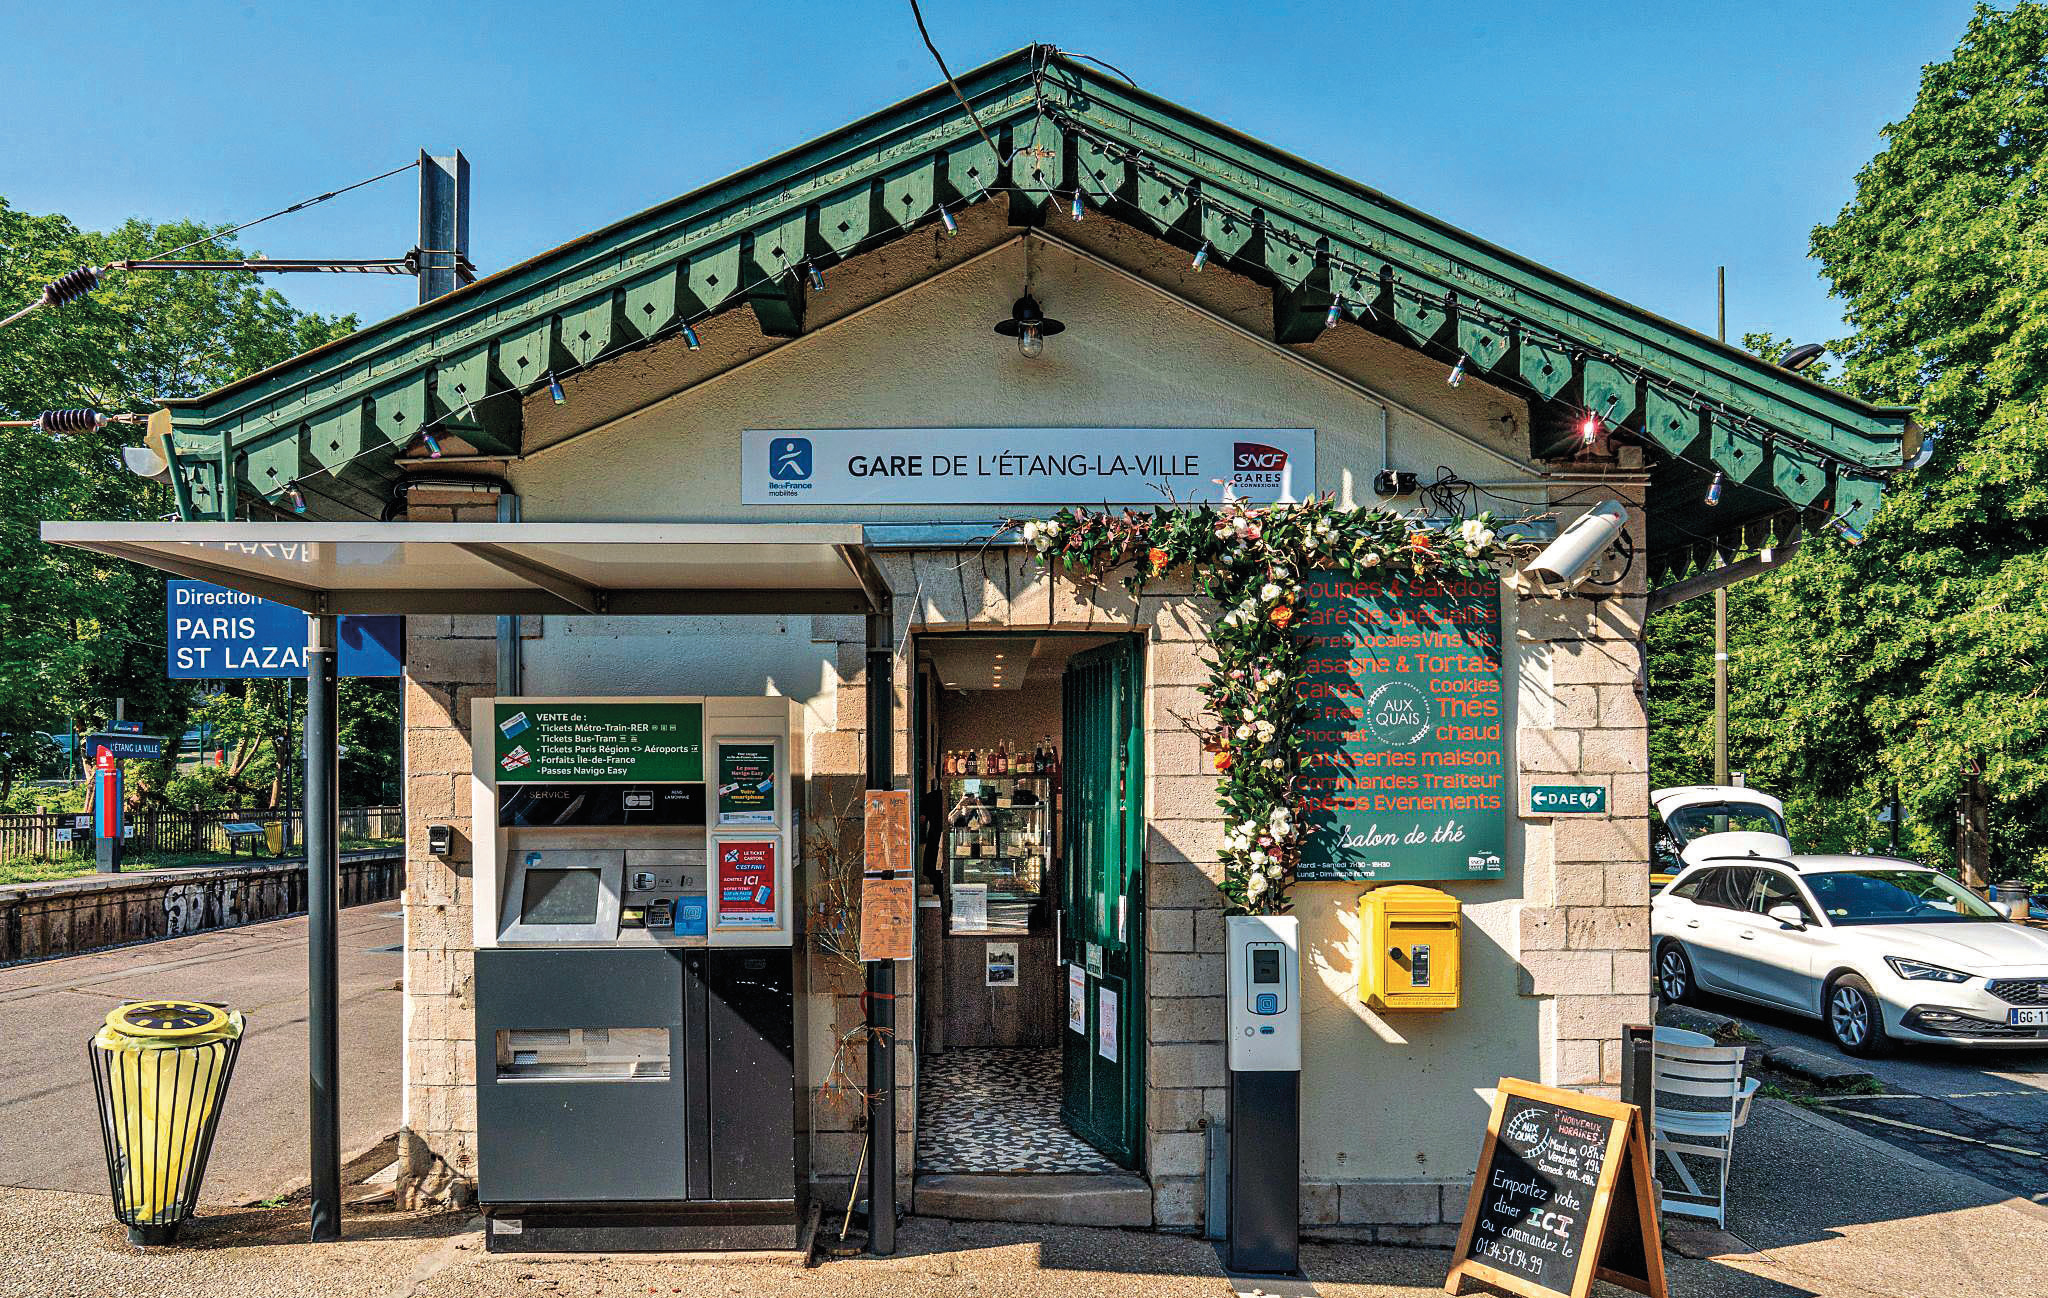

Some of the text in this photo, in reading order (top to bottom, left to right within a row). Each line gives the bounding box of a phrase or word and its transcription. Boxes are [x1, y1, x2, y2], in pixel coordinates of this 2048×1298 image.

[849, 450, 1199, 477] GARE DE L'ÉTANG-LA-VILLE
[1236, 453, 1284, 468] SNCF
[1233, 473, 1281, 482] GARES
[1389, 578, 1404, 597] &
[176, 588, 262, 605] Direction
[176, 618, 255, 640] PARIS
[1354, 632, 1420, 648] Locales
[1421, 631, 1463, 648] Vins
[176, 647, 212, 669] ST
[1395, 655, 1410, 673] &
[1414, 653, 1499, 673] Tortas
[1429, 678, 1500, 693] Cookies
[1383, 699, 1414, 712] AUX
[1433, 693, 1499, 717] Thés
[536, 713, 569, 721] VENTE
[570, 713, 582, 721] de
[1375, 712, 1420, 727] QUAIS
[541, 723, 649, 732] Tickets Métro-Train-RER
[1436, 723, 1500, 741] chaud
[541, 734, 617, 743] Tickets Bus-Tram
[135, 744, 143, 753] LA
[143, 745, 158, 753] VILLE
[541, 745, 573, 753] Tickets
[575, 744, 597, 753] Paris
[599, 744, 630, 755] Région
[644, 744, 689, 755] Aéroports
[541, 754, 636, 764] Forfaits Île-de-France
[1421, 749, 1501, 767] maison
[541, 766, 628, 777] Passes Navigo Easy
[1296, 773, 1502, 790] Commandes Traiteur
[529, 790, 570, 799] SERVICE
[1548, 793, 1579, 805] DAE
[1337, 819, 1466, 849] Salon de thé
[743, 875, 759, 885] ICI
[1521, 1121, 1540, 1134] AUX
[1561, 1114, 1601, 1132] NOUVEAUX
[1515, 1130, 1539, 1144] QUAIS
[1558, 1124, 1599, 1142] HORAIRES
[1548, 1136, 1568, 1153] Mardi
[1580, 1144, 1600, 1160] 08h
[1537, 1158, 1564, 1176] Samedi
[1547, 1149, 1601, 1174] Vendredi 19h
[1492, 1169, 1580, 1211] Emportez votre
[1526, 1207, 1574, 1238] ICI
[1481, 1219, 1574, 1258] ou commandez le
